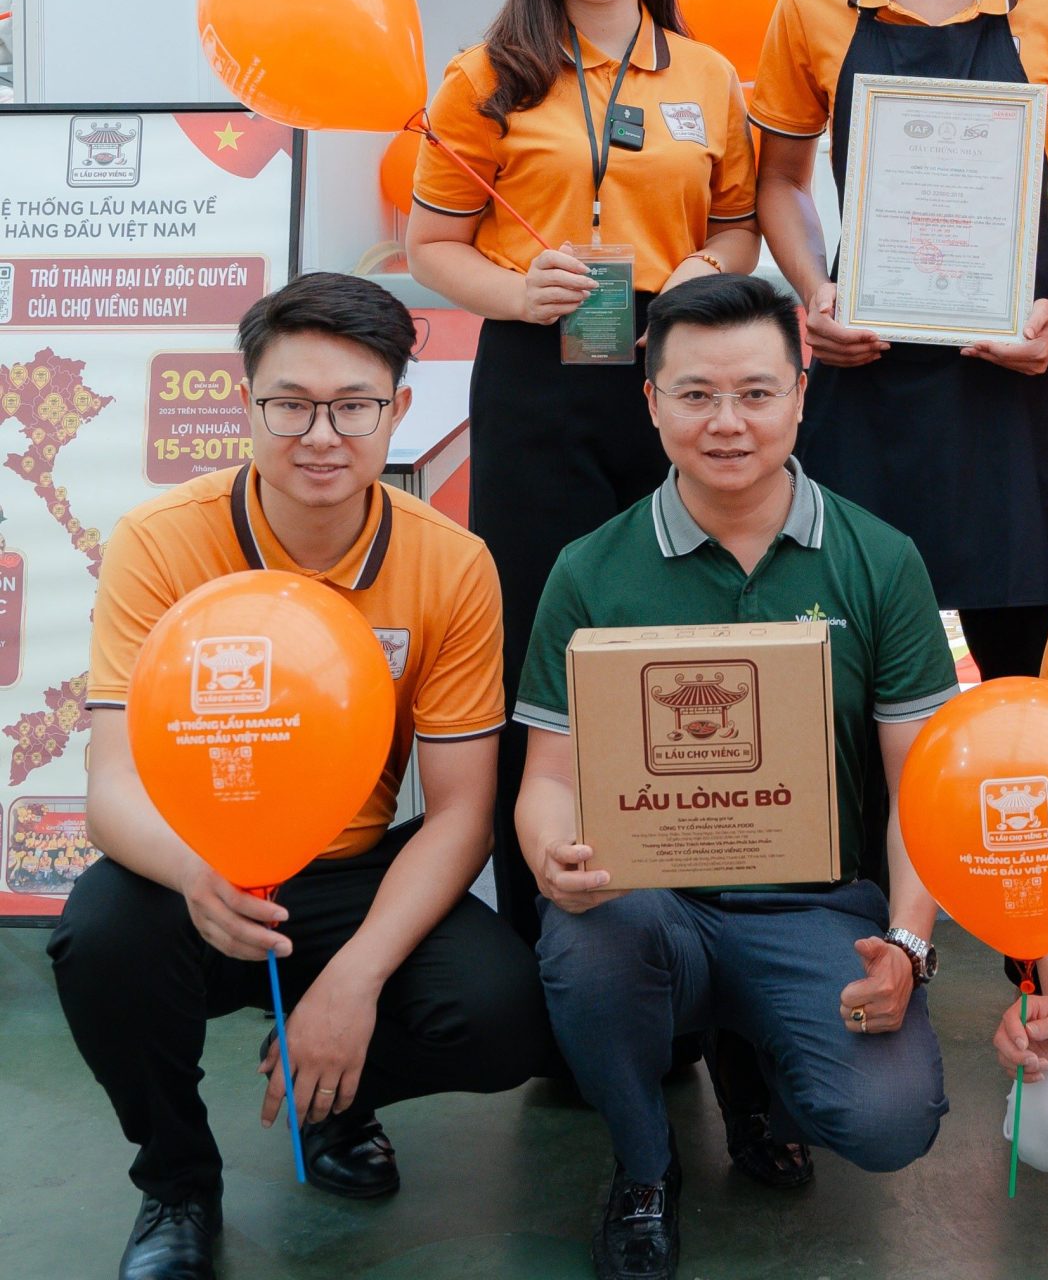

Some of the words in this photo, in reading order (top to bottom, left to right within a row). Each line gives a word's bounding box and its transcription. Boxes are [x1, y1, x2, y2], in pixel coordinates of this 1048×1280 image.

[17, 196, 84, 217] THỐNG
[90, 196, 124, 216] LẨU
[130, 199, 188, 215] MANG
[193, 195, 217, 214] VỀ
[5, 220, 59, 239] HÀNG
[64, 219, 102, 238] ĐẦU
[108, 220, 148, 242] VIỆT
[153, 222, 196, 237] NAM
[30, 265, 58, 288] TRỞ
[62, 265, 112, 288] THÀNH
[115, 268, 140, 291] ĐẠI
[144, 264, 160, 287] LÝ
[164, 264, 195, 290] ĐỘC
[197, 263, 248, 289] QUYỀN
[28, 293, 57, 318] CỦA
[61, 297, 92, 321] CHỢ
[95, 292, 139, 317] VIỀNG
[143, 296, 187, 317] NGAY!
[159, 407, 176, 415] 2025
[177, 406, 196, 415] TRÊN
[171, 423, 193, 437] LỢI
[196, 421, 240, 437] NHUẬN
[687, 749, 709, 760] CHỢ
[618, 784, 670, 812] LẨU
[676, 786, 749, 810] LÒNG
[755, 783, 792, 806] BÒ
